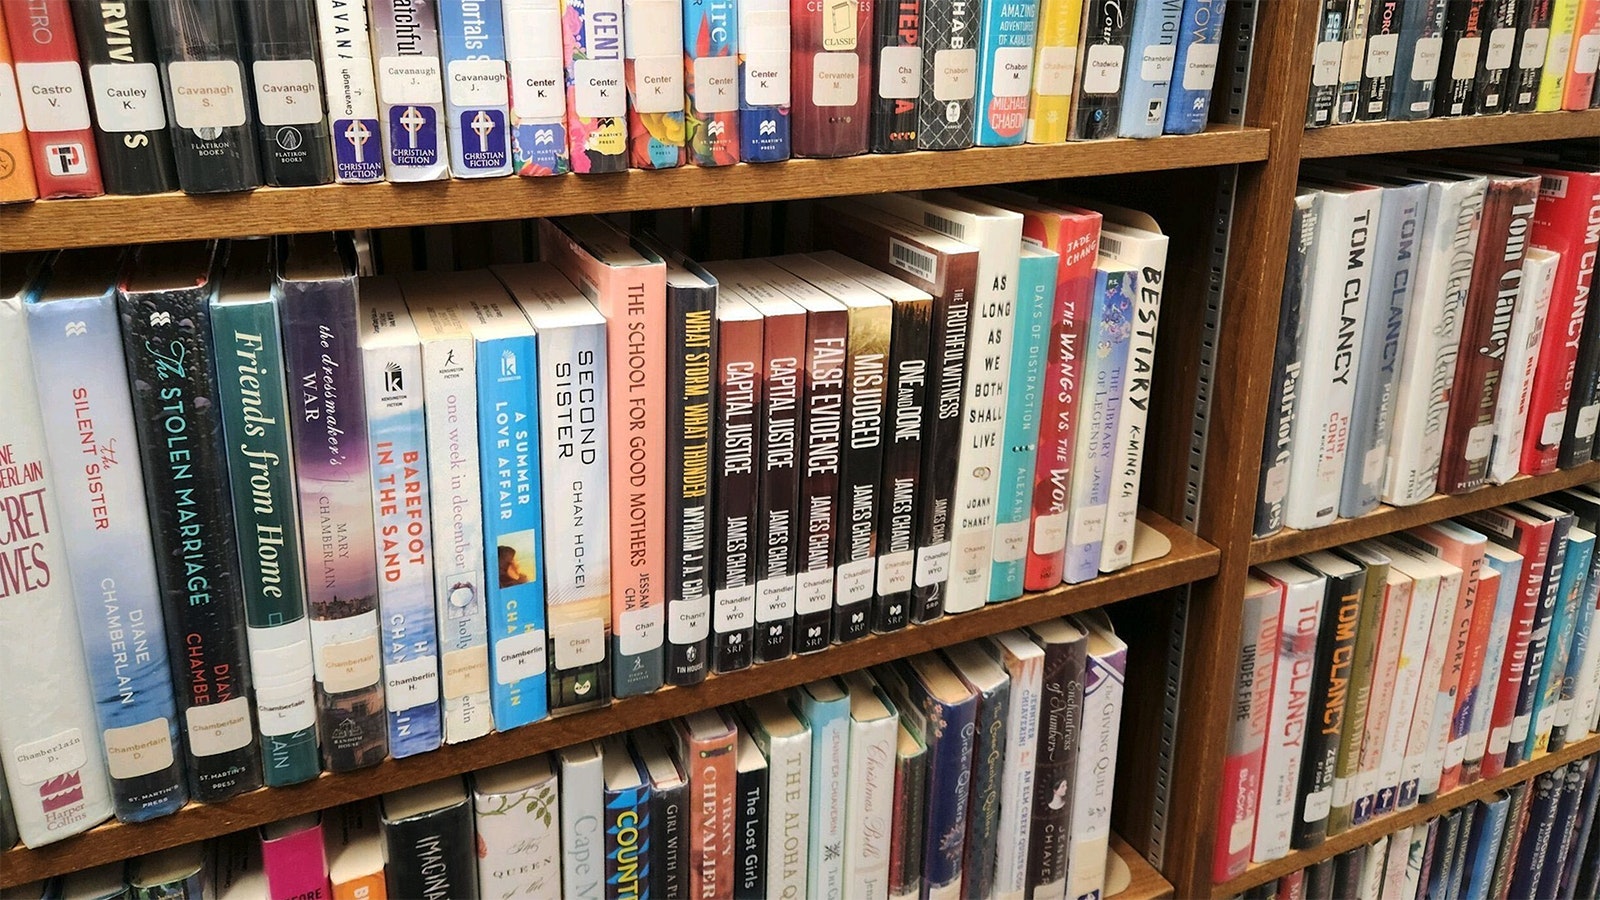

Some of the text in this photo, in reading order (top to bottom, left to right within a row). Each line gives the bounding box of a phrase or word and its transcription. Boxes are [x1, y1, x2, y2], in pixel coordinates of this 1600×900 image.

[1001, 4, 1036, 18] AMAZING
[824, 37, 857, 46] CLASSIC
[262, 83, 315, 95] Cavanagh
[388, 66, 437, 77] Cavanaugh
[454, 73, 506, 84] Cavanaugh
[526, 78, 556, 88] Center
[589, 78, 618, 87] Center
[643, 74, 672, 85] Center
[708, 76, 734, 87] Center
[751, 70, 778, 79] Center
[818, 71, 855, 81] Cervantes
[1004, 63, 1029, 72] Chabon
[31, 84, 73, 96] Castro
[106, 87, 148, 99] Cauley
[177, 84, 234, 98] Cavanagh
[342, 67, 353, 116] Cavanaugh
[992, 98, 1027, 111] MICHAEL
[338, 162, 382, 173] CHRISTIAN
[392, 148, 436, 159] CHRISTIAN
[397, 156, 431, 165] FICTION
[464, 152, 505, 162] CHRISTIAN
[469, 159, 501, 169] FICTION
[1066, 233, 1092, 253] JADE
[1066, 240, 1097, 267] CHANG
[992, 276, 1007, 292] AS
[1332, 209, 1371, 386] TOM CLANCY
[1380, 202, 1419, 374] TOM CLANCY
[1479, 197, 1538, 361] Tom Clancy
[1566, 250, 1597, 350] CLANCY
[981, 300, 1011, 319] LONG
[938, 288, 970, 421] THE TRUTHFUL WITNESS
[987, 329, 1002, 345] AS
[1023, 284, 1046, 431] DAYS OF DISTRACTION
[1129, 266, 1162, 411] BESTIARY
[984, 355, 1001, 372] WE
[1056, 301, 1078, 463] THE WANGS VS. THE
[302, 371, 321, 423] WAR
[318, 324, 347, 467] the dressmaker's
[555, 362, 574, 460] SISTER
[578, 350, 596, 465] SECOND
[682, 309, 712, 499] WHAT STORM, WHAT THUNDER
[807, 337, 846, 477] FALSE EVIDENCE
[851, 353, 885, 450] MISJUDGED
[894, 359, 926, 444] ONE AND DONE
[974, 381, 1004, 398] BOTH
[1277, 361, 1301, 449] Patriot
[628, 283, 647, 568] THE SCHOOL FOR GOOD MOTHERS
[724, 361, 755, 477] CAPITAL JUSTICE
[767, 357, 798, 471] CAPITAL JUSTICE
[969, 408, 1002, 424] SHALL
[72, 387, 109, 531] SILENT SISTER
[495, 401, 513, 521] LOVE AFFAIR
[514, 411, 530, 506] A SUMMER
[973, 432, 996, 449] LIVE
[145, 339, 210, 607] The STOLEN MARRIAGE
[234, 329, 285, 599] Friends from Home
[446, 394, 471, 570] one week in december
[375, 442, 401, 584] IN THE SAND
[402, 451, 426, 566] BAREFOOT
[810, 495, 832, 540] JAMES
[852, 484, 873, 525] JAMES
[893, 478, 914, 515] JAMES
[318, 495, 336, 590] CHAMBERLAIN
[336, 522, 349, 560] MARY
[572, 480, 586, 590] CHAN HO-KEI
[682, 505, 705, 552] MYRIAM
[727, 516, 748, 553] JAMES
[768, 509, 790, 546] JAMES
[962, 515, 991, 529] CHANEY
[1556, 535, 1568, 558] THE
[848, 584, 866, 594] WYO
[888, 574, 906, 584] WYO
[927, 566, 943, 576] WYO
[1464, 558, 1482, 609] ELIZA
[1524, 562, 1544, 607] LAST
[1543, 562, 1564, 608] LIES
[726, 613, 745, 622] WYO
[768, 601, 787, 611] WYO
[808, 593, 827, 603] WYO
[1335, 588, 1362, 642] TOM
[100, 577, 135, 705] CHAMBERLAIN
[129, 609, 150, 664] DIANE
[569, 636, 591, 648] Chan
[635, 620, 655, 632] Chan
[1452, 618, 1470, 674] CLARK
[500, 645, 544, 664] Chamberlin
[1527, 630, 1547, 686] TELL
[388, 671, 437, 689] Chamberlin
[1236, 644, 1257, 721] UNDER FIRE
[1321, 645, 1354, 736] CLANCY
[1282, 658, 1312, 748] CLANCY
[108, 735, 168, 755] Chamberlain
[1100, 702, 1114, 755] GIVING
[1093, 756, 1110, 799] QUILT
[44, 802, 86, 824] Harper
[46, 812, 88, 832] Collins
[703, 765, 718, 900] CHEVALIER
[721, 792, 734, 857] TRACY
[783, 752, 802, 881] THE ALOHA
[568, 815, 598, 876] Cape
[666, 804, 679, 884] GIRL WITH A
[744, 787, 760, 890] The Lost Girls
